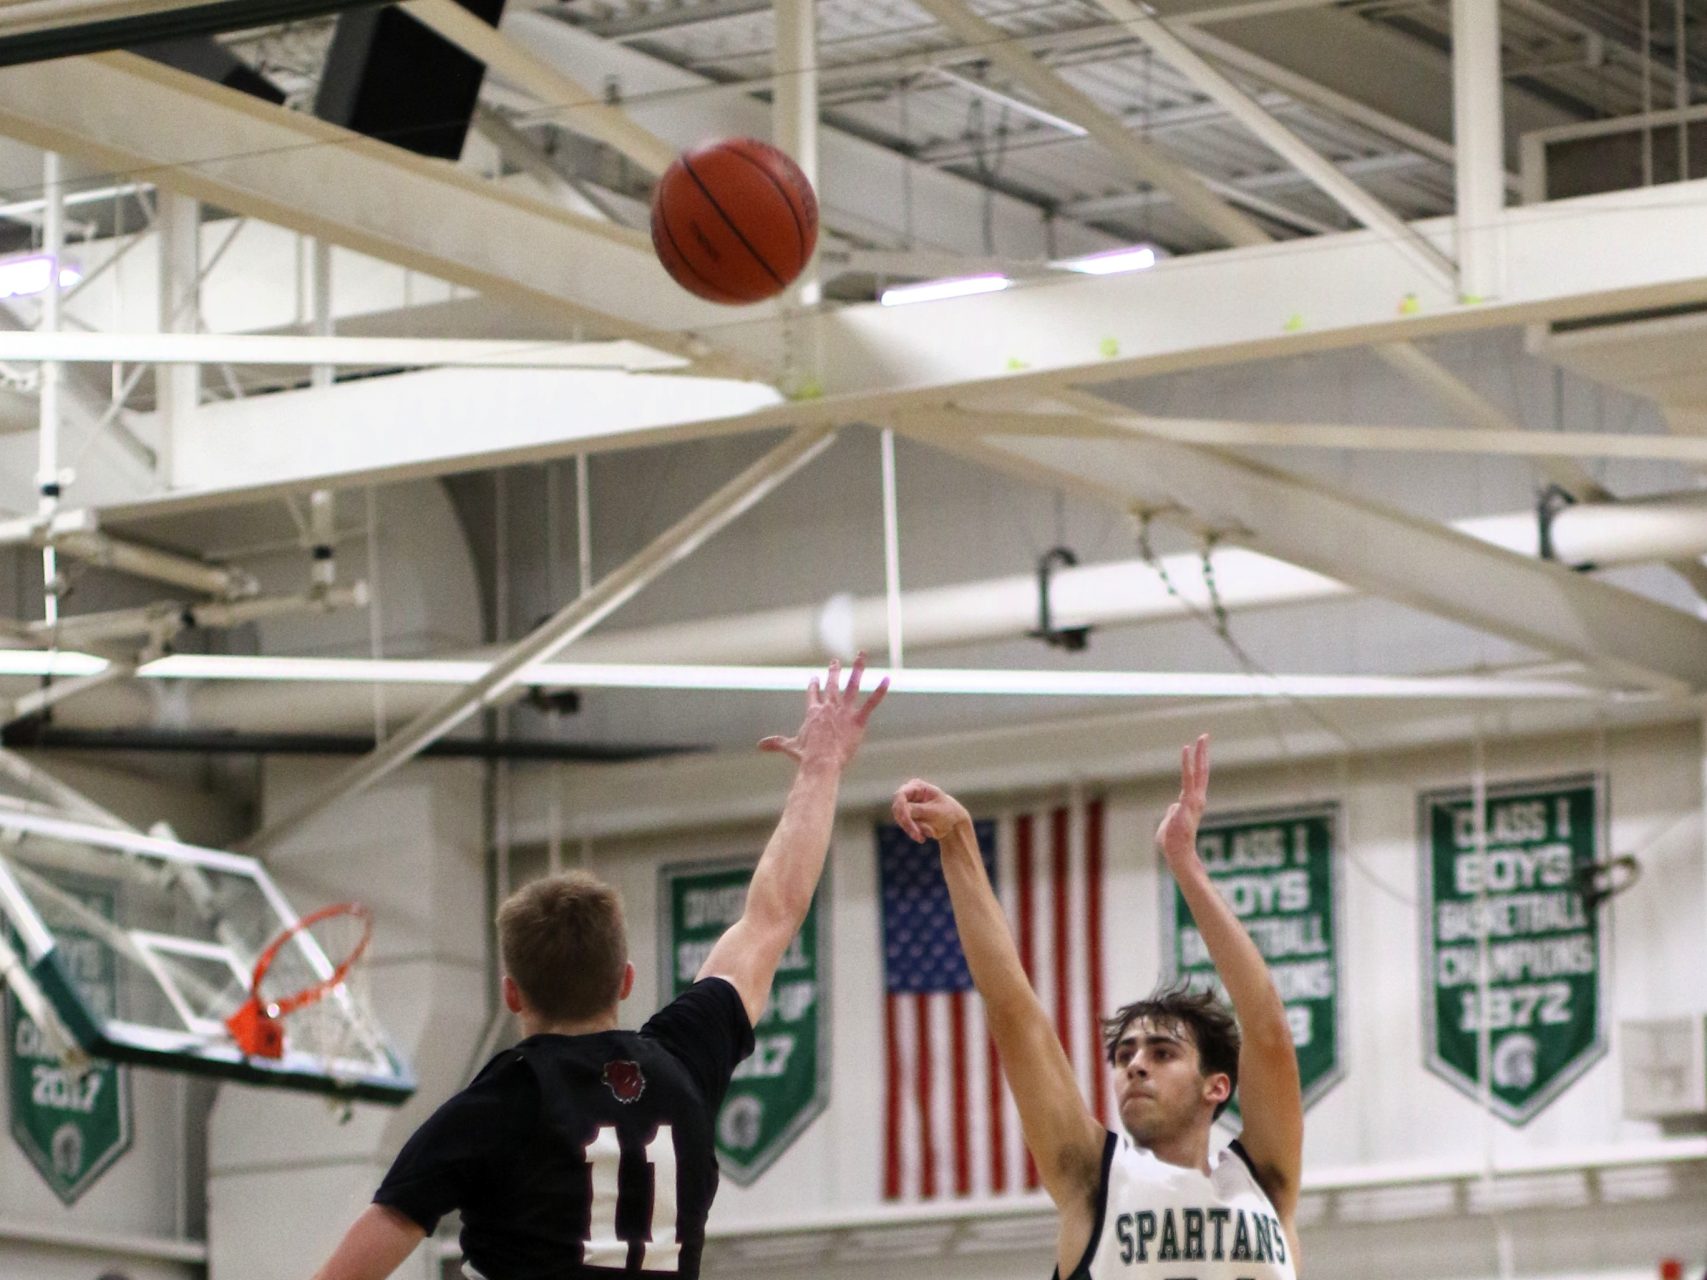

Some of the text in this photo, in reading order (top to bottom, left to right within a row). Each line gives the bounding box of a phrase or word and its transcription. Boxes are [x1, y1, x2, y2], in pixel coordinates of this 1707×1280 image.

[1455, 844, 1572, 894] BOYS
[583, 1125, 682, 1272] 11
[1116, 1207, 1286, 1266] SPARTANS
